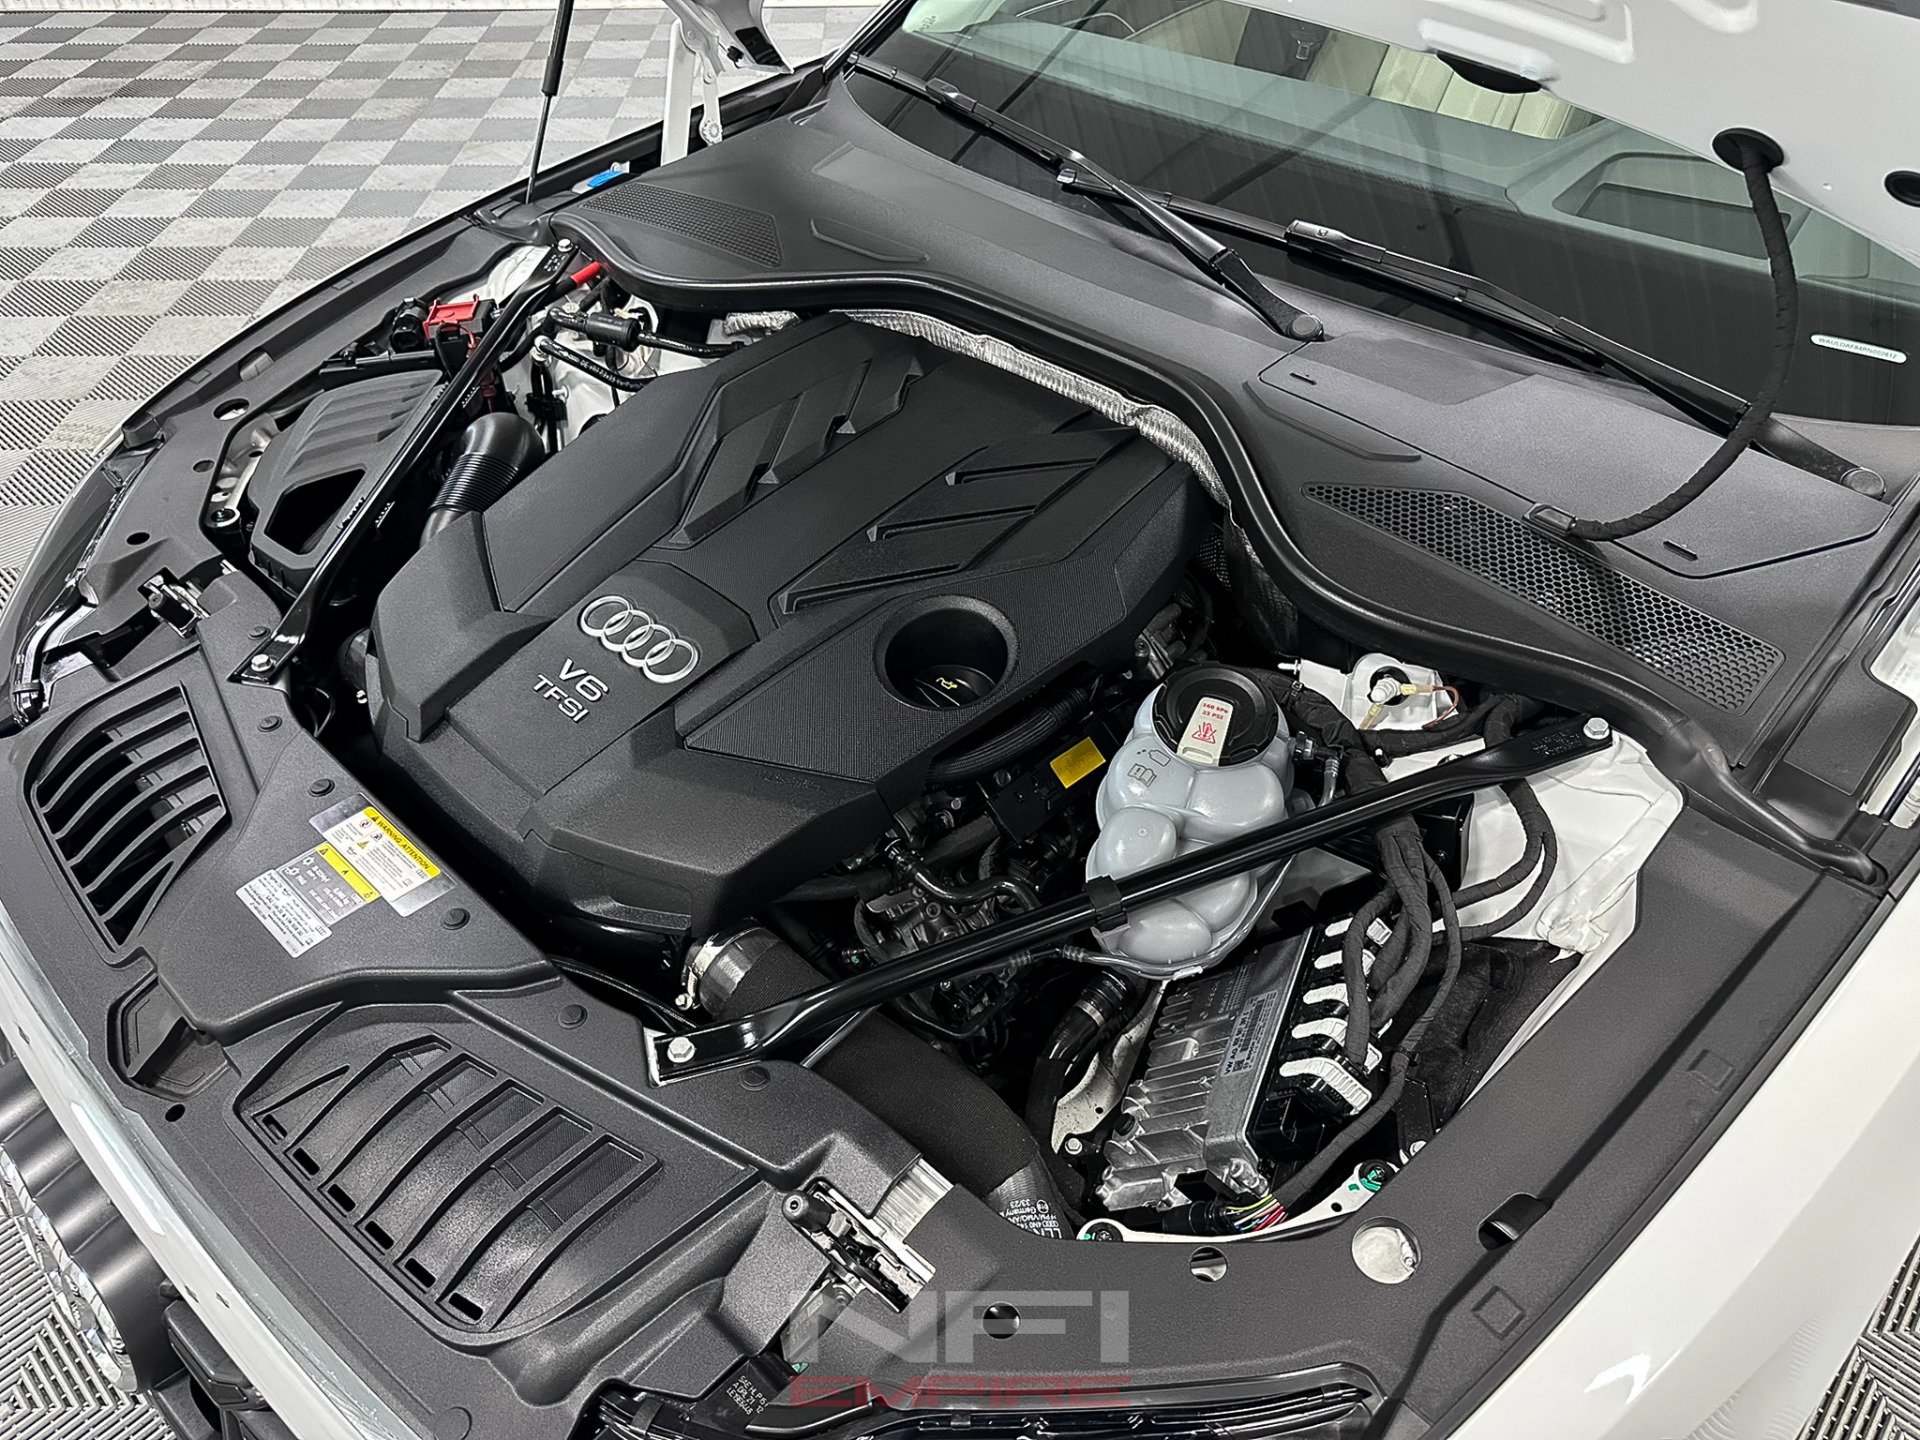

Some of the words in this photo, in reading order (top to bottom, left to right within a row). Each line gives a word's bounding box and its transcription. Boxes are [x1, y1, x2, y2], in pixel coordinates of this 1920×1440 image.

[558, 658, 609, 702] V6
[533, 674, 589, 722] TFSI
[1212, 712, 1224, 720] PSI
[377, 819, 402, 844] WARNING
[401, 843, 430, 870] ATTENTION
[1010, 1198, 1031, 1209] 33/23
[1006, 1206, 1037, 1217] Germany
[739, 1375, 752, 1389] SAE
